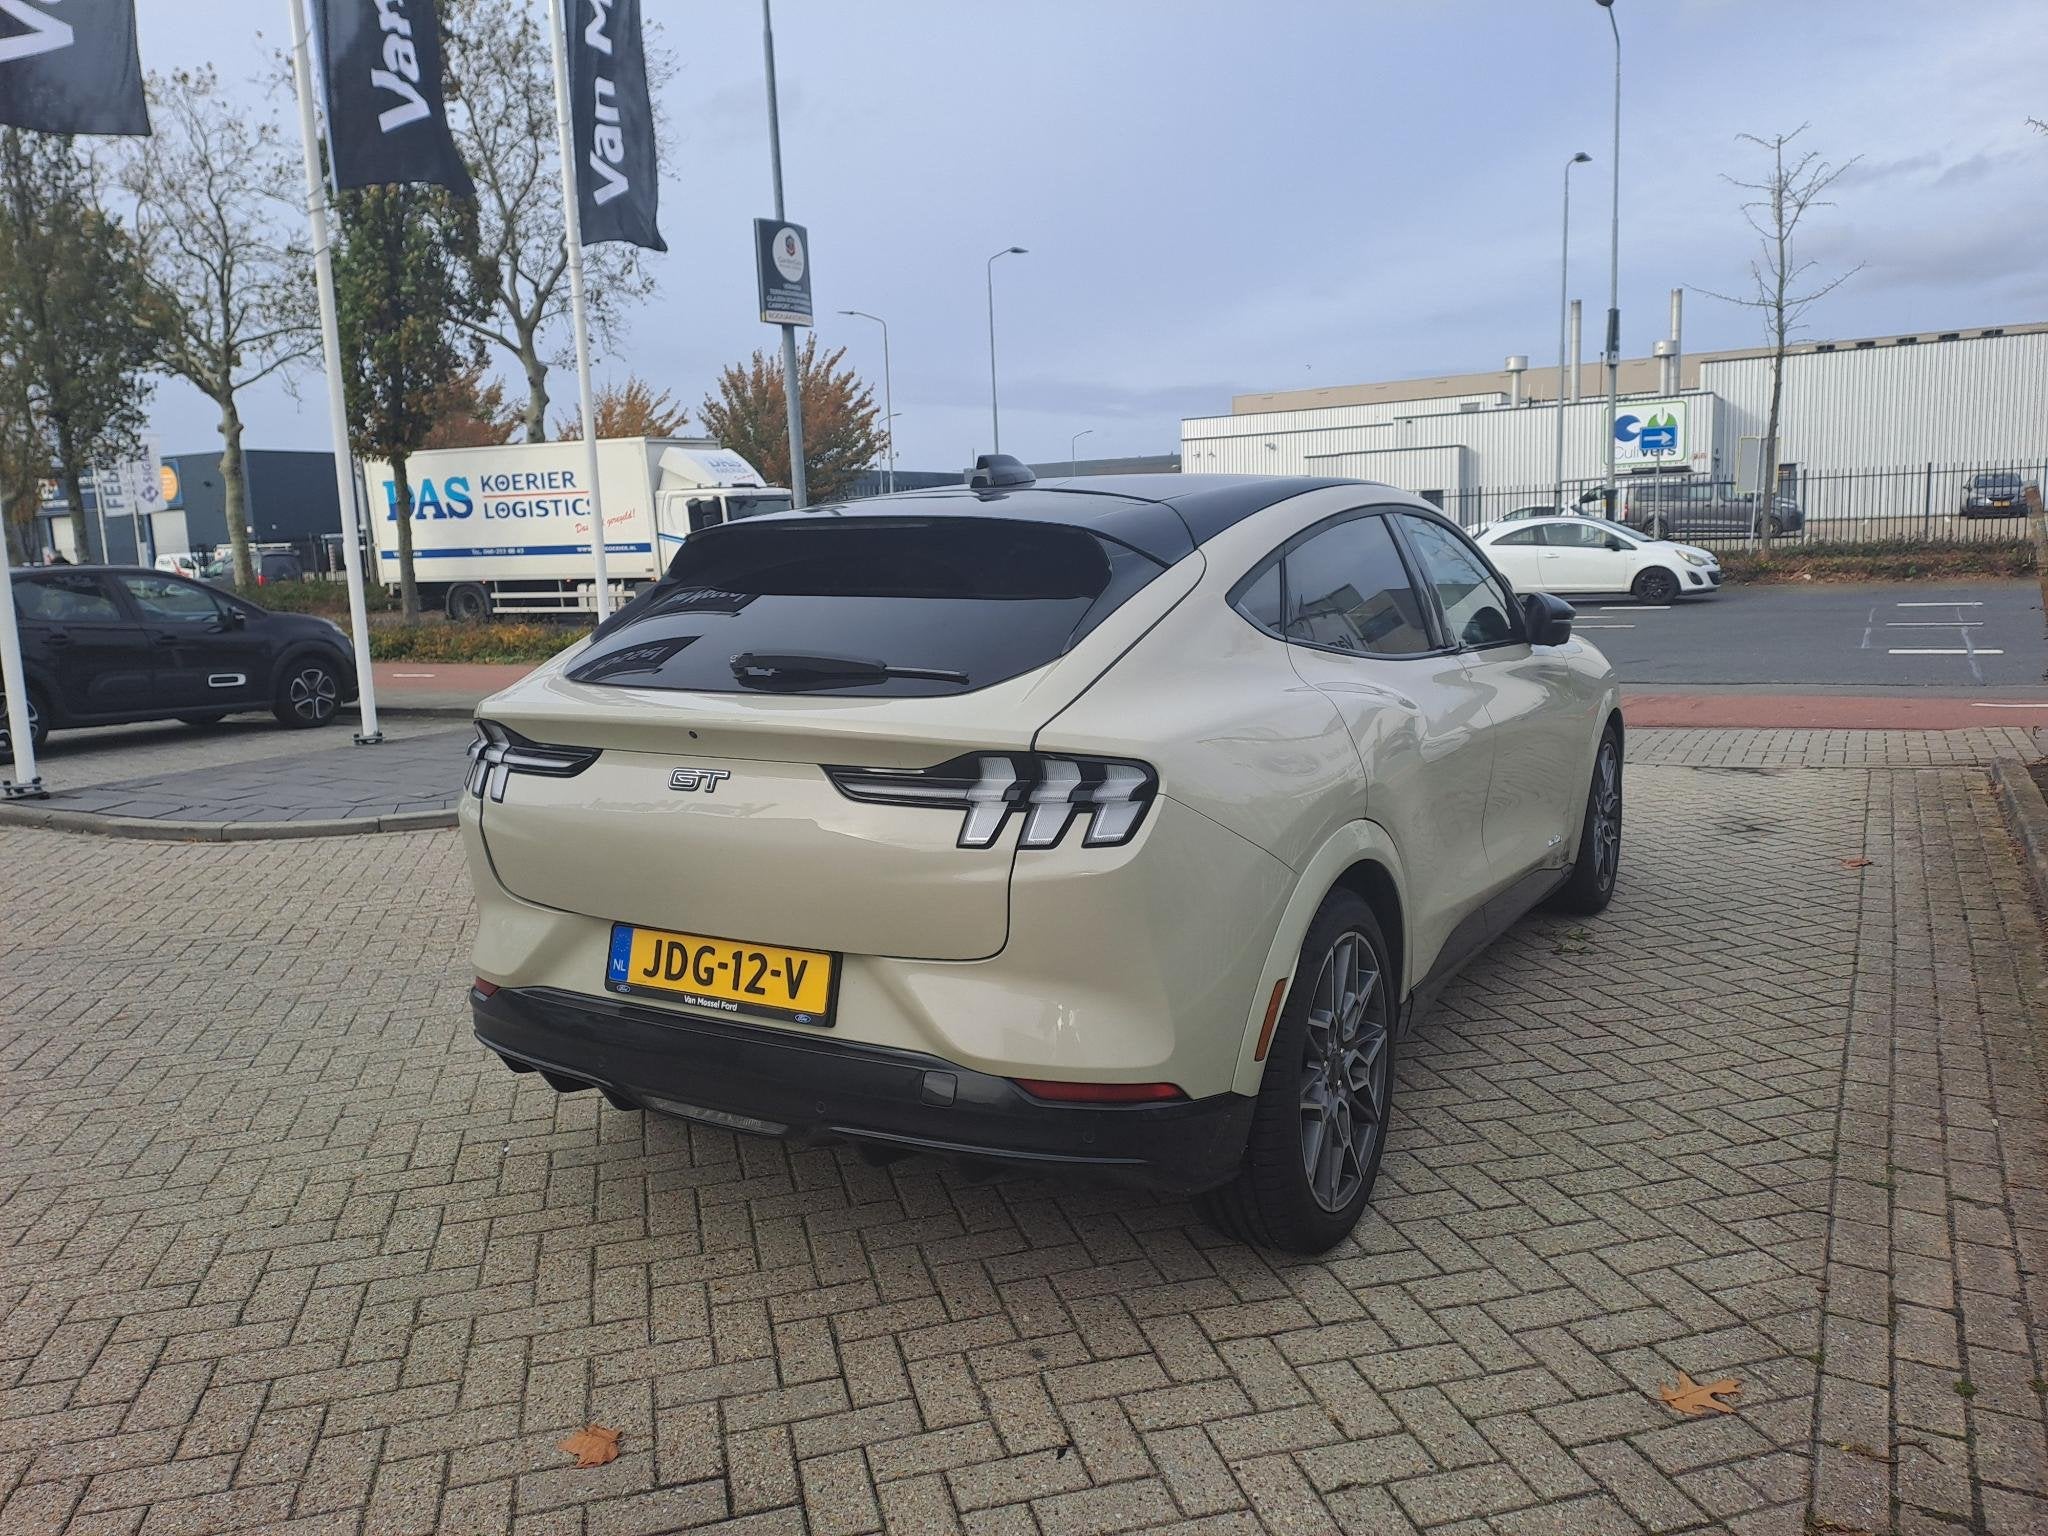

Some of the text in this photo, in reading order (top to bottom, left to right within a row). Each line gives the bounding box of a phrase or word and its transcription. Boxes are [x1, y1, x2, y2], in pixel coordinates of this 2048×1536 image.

[589, 77, 629, 206] Van
[481, 470, 577, 492] KOERIER
[668, 767, 730, 793] GT
[612, 958, 627, 972] NL
[642, 939, 808, 1000] JDG-12-V
[684, 995, 738, 1012] Van Mossel Ford
